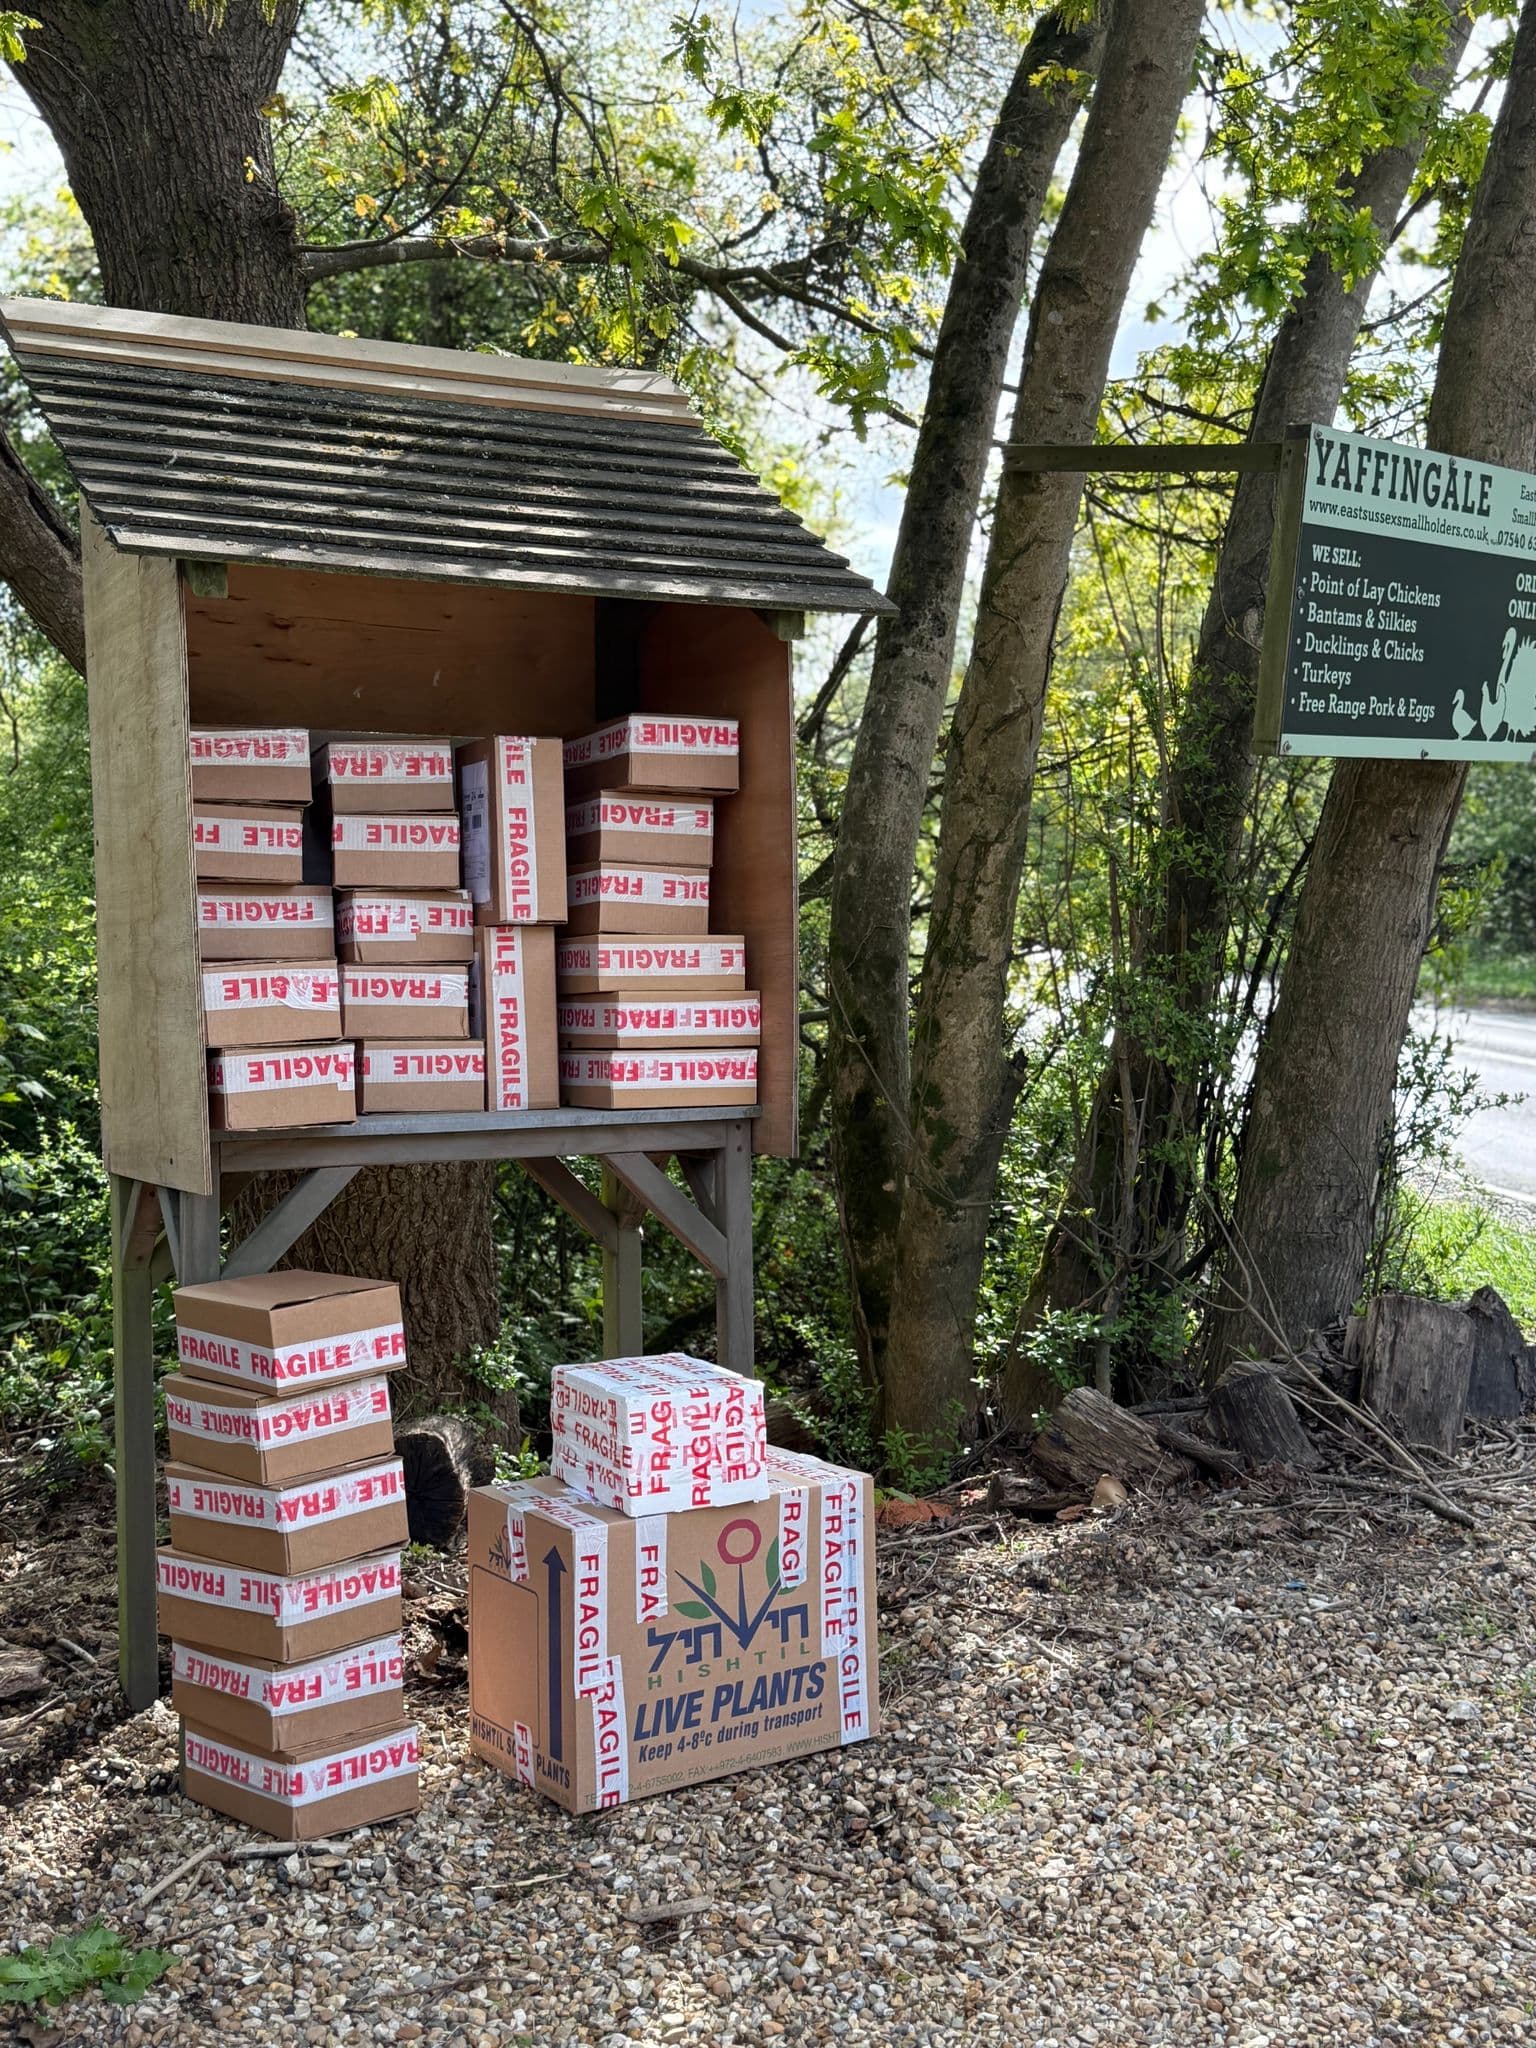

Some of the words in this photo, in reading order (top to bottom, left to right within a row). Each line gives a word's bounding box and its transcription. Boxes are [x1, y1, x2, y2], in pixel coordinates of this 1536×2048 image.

[1314, 437, 1493, 517] YAFFINGALE
[1309, 500, 1489, 542] www.eastsussexsmallholders.co.uk
[1312, 544, 1331, 563] WE
[1332, 547, 1362, 568] SELL:
[1310, 571, 1345, 596] Point
[1347, 578, 1361, 597] of
[1363, 579, 1385, 606] Lay
[1387, 582, 1441, 607] Chickens
[1307, 602, 1362, 627] Bantams
[1365, 608, 1376, 629] &
[1378, 610, 1417, 633] Silkies
[1304, 632, 1369, 662] Ducklings
[1371, 638, 1381, 659] &
[1384, 639, 1425, 662] Chicks
[1302, 661, 1352, 690] Turkeys
[1299, 692, 1325, 713] Free
[1329, 693, 1366, 720] Range
[1369, 696, 1395, 717] Pork
[1397, 697, 1406, 717] &
[1408, 698, 1435, 722] Eggs
[508, 808, 532, 920] FRAGILE
[202, 901, 314, 921] FRAGILE
[597, 948, 700, 969] FRAGILE
[499, 997, 522, 1109] FRAGILE
[180, 1335, 241, 1369] FRAGILE
[250, 1344, 353, 1380] FRAGILE
[193, 1487, 265, 1519] FRAGILE
[157, 1562, 225, 1598] FRAGIL
[823, 1494, 844, 1638] FRAGILE
[187, 1656, 250, 1698] FRAGILE
[647, 1642, 810, 1691] HISHTIL
[633, 1689, 705, 1742] LIVE
[710, 1660, 827, 1723] PLANTS
[638, 1743, 673, 1763] Keep
[717, 1721, 759, 1744] during
[764, 1702, 824, 1732] transport
[186, 1738, 250, 1785] FRAGILE
[471, 1718, 504, 1752] HISHTIL
[536, 1753, 571, 1790] PLANTS
